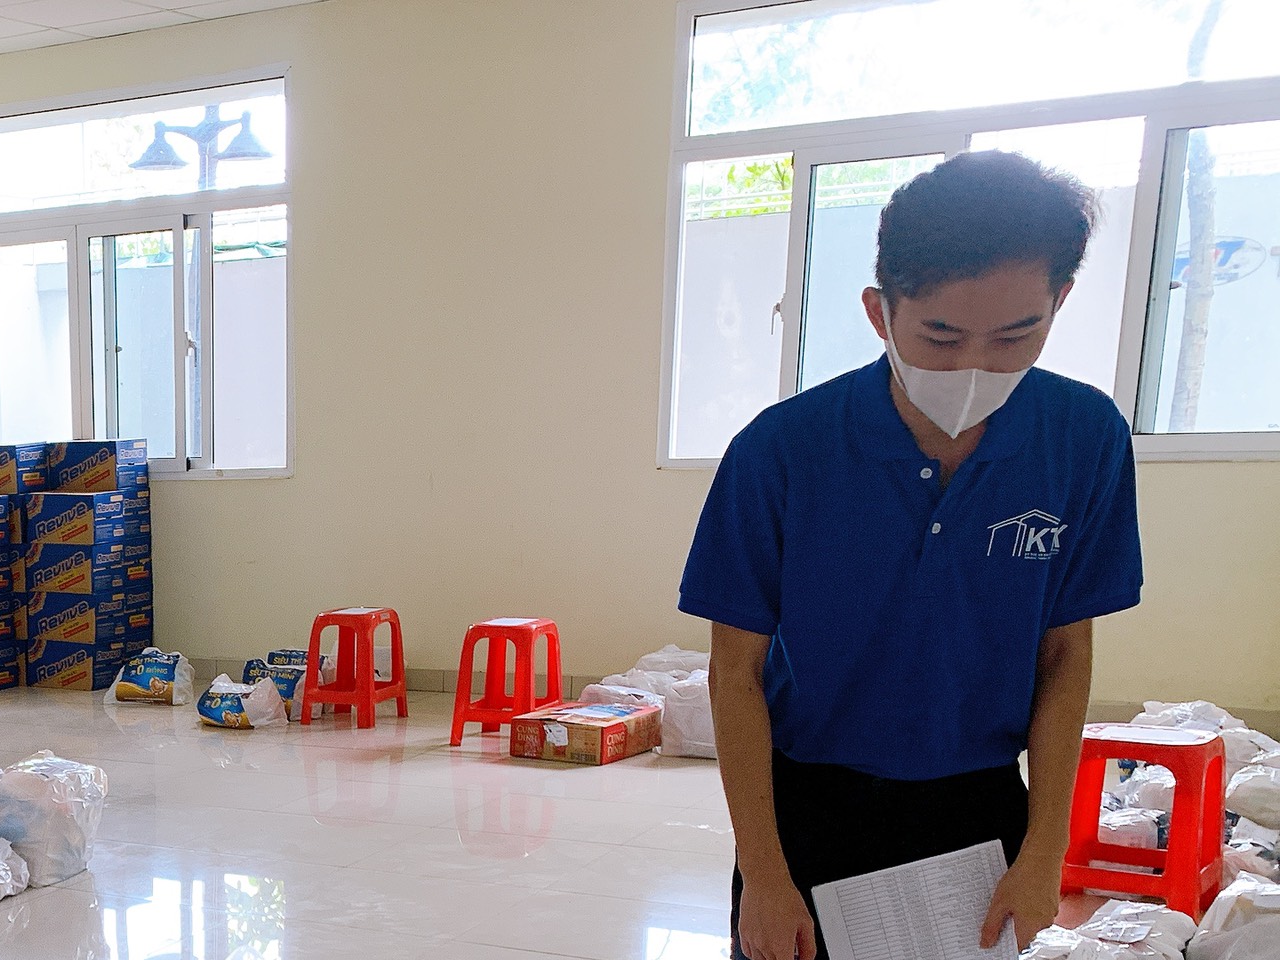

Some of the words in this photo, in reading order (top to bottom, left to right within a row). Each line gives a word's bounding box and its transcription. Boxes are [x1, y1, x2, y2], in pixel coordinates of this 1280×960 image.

[59, 448, 110, 486] Revive
[35, 501, 88, 540] Revive
[34, 551, 86, 588] Revive
[39, 601, 89, 634] Revive
[37, 650, 87, 681] Revive
